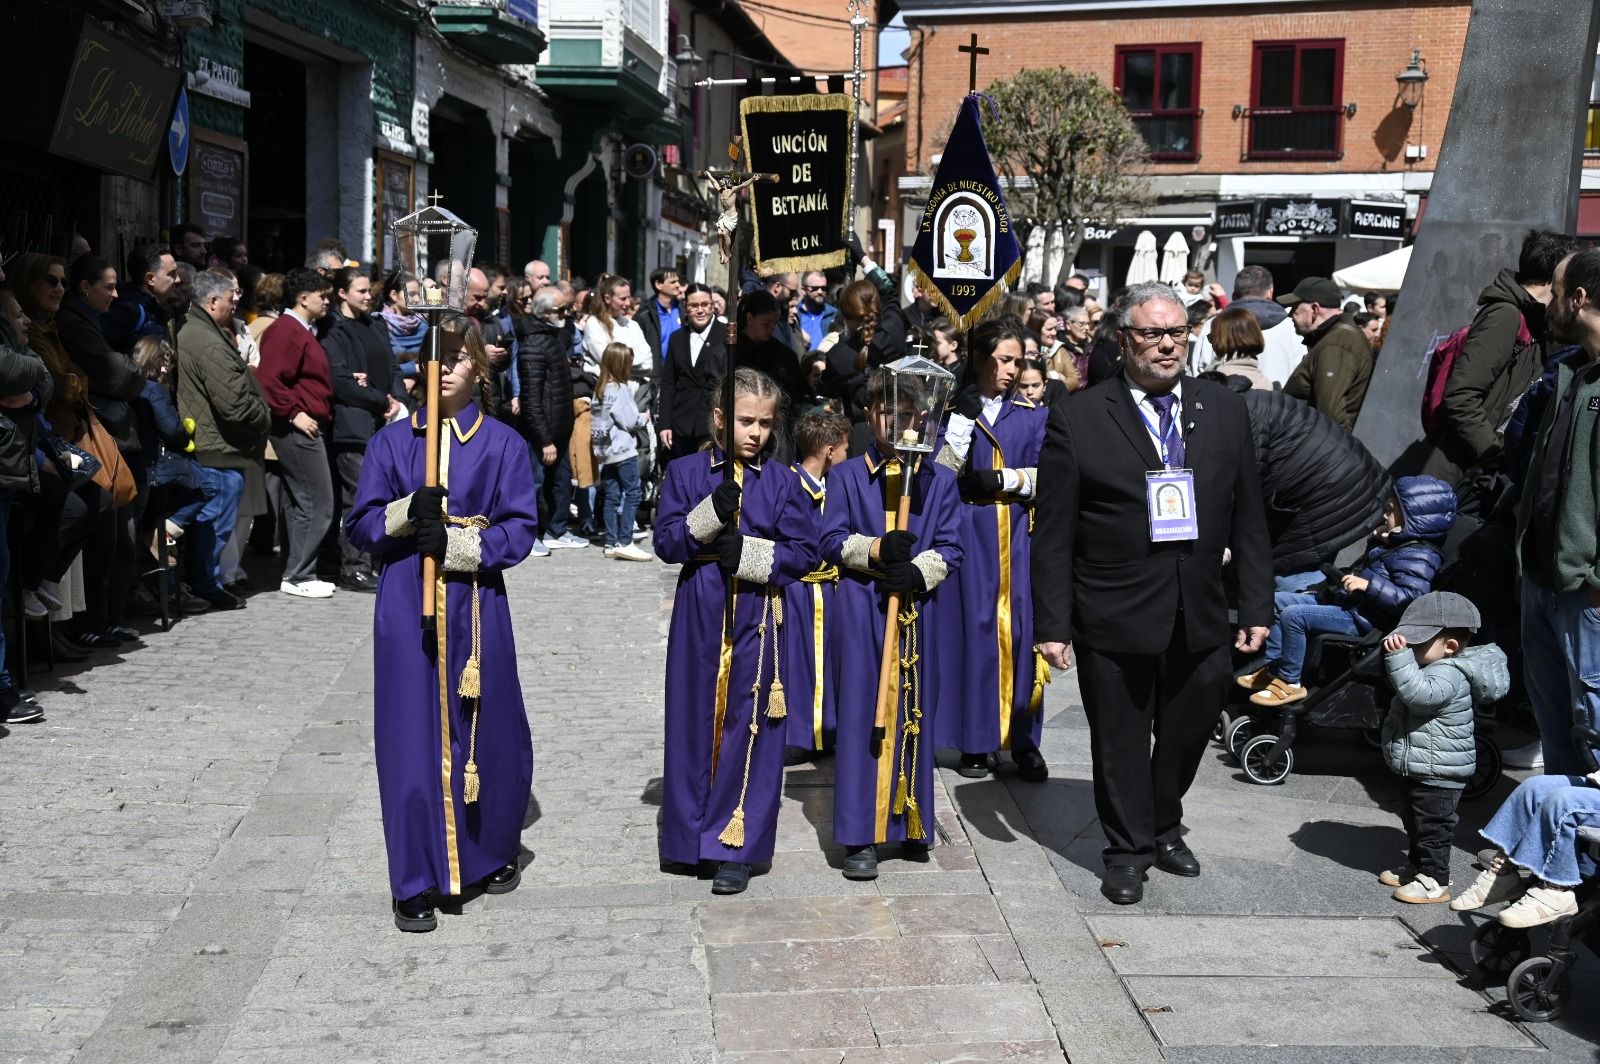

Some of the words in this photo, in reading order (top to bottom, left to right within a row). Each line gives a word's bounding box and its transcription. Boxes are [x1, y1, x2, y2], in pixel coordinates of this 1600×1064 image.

[211, 62, 239, 88] PATIO
[792, 162, 812, 184] DE
[772, 188, 829, 216] BETANÍA
[922, 220, 931, 233] LA
[947, 181, 958, 193] DE
[959, 179, 999, 203] NUESTRO
[995, 202, 1009, 233] SEÑOR
[1354, 211, 1401, 229] PIERCING
[1084, 226, 1118, 240] Bar
[951, 284, 976, 297] 1993
